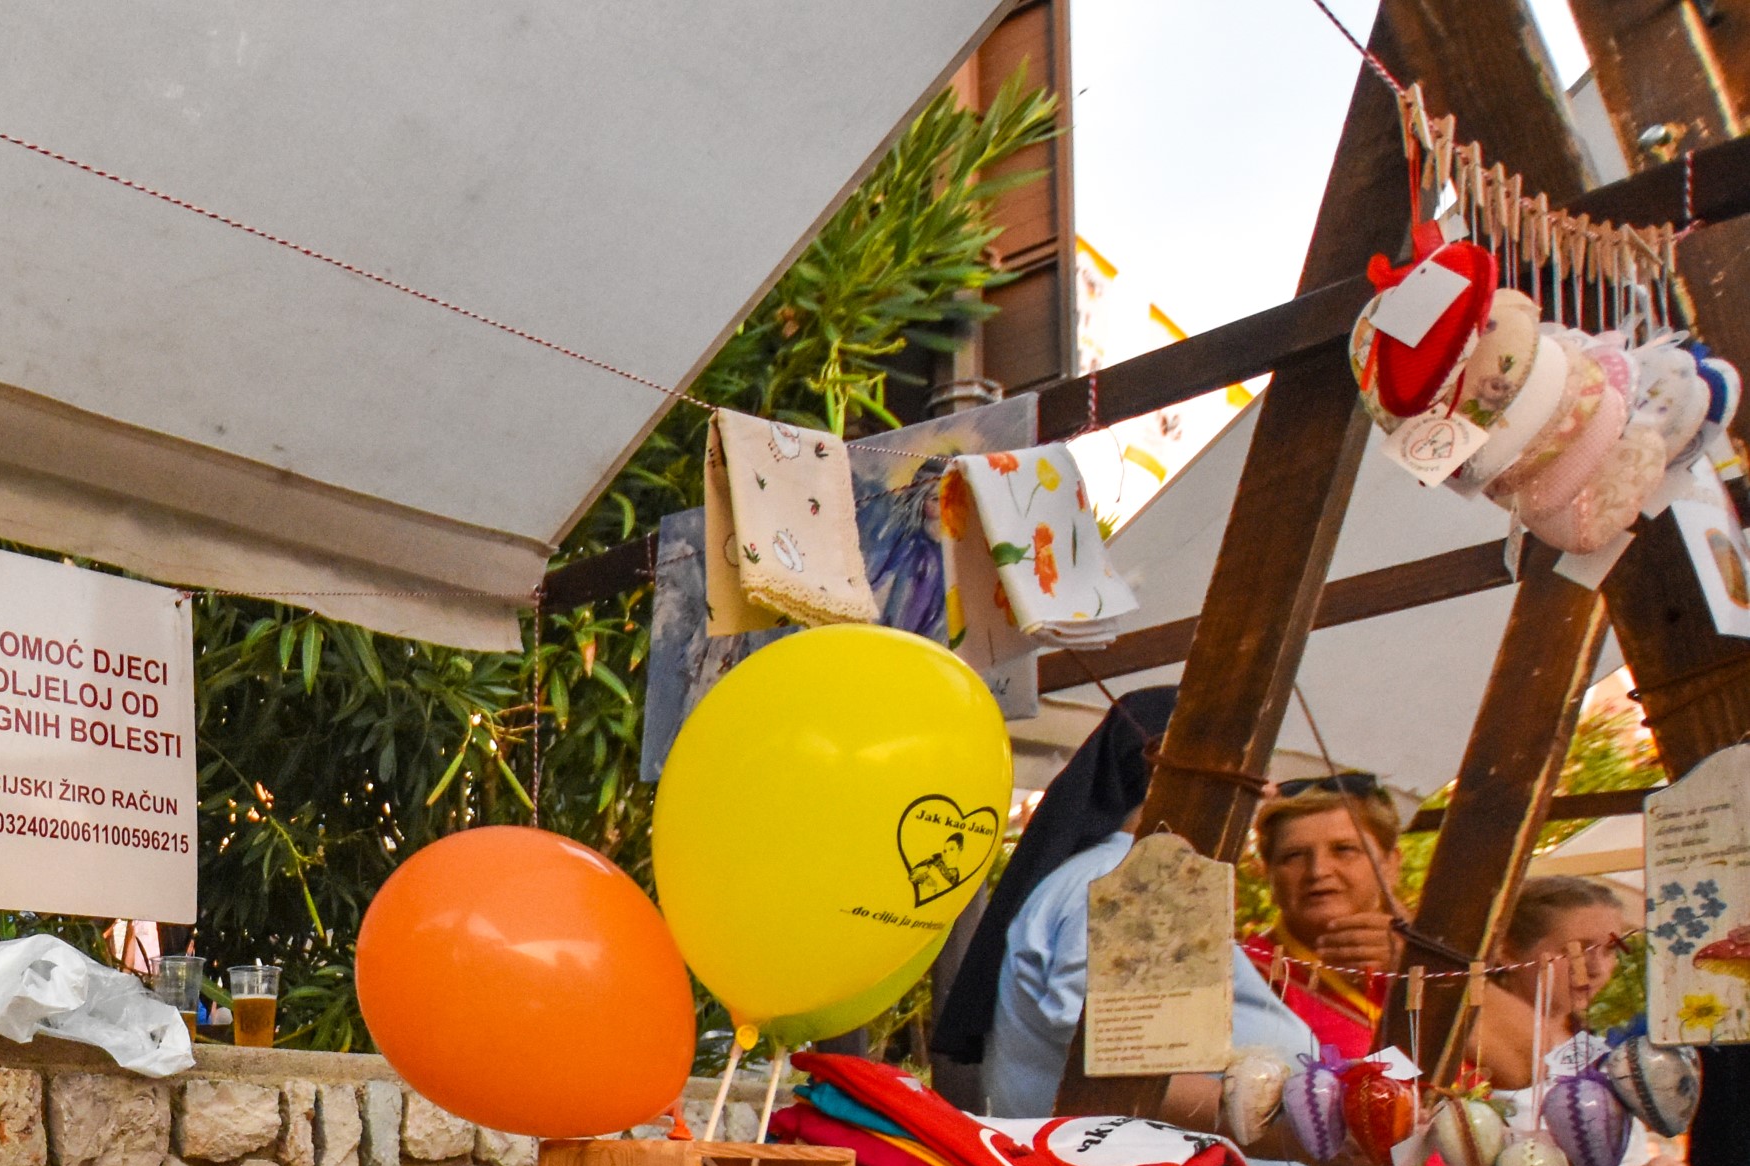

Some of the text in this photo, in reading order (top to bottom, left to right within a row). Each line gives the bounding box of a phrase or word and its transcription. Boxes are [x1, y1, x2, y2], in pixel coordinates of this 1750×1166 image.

[94, 649, 168, 686] DJECI
[122, 690, 159, 719] OD
[71, 721, 182, 759] BOLESTI
[59, 778, 106, 806] ŽIRO
[112, 788, 178, 816] RAČUN
[915, 809, 941, 824] Jak
[944, 816, 966, 830] kao
